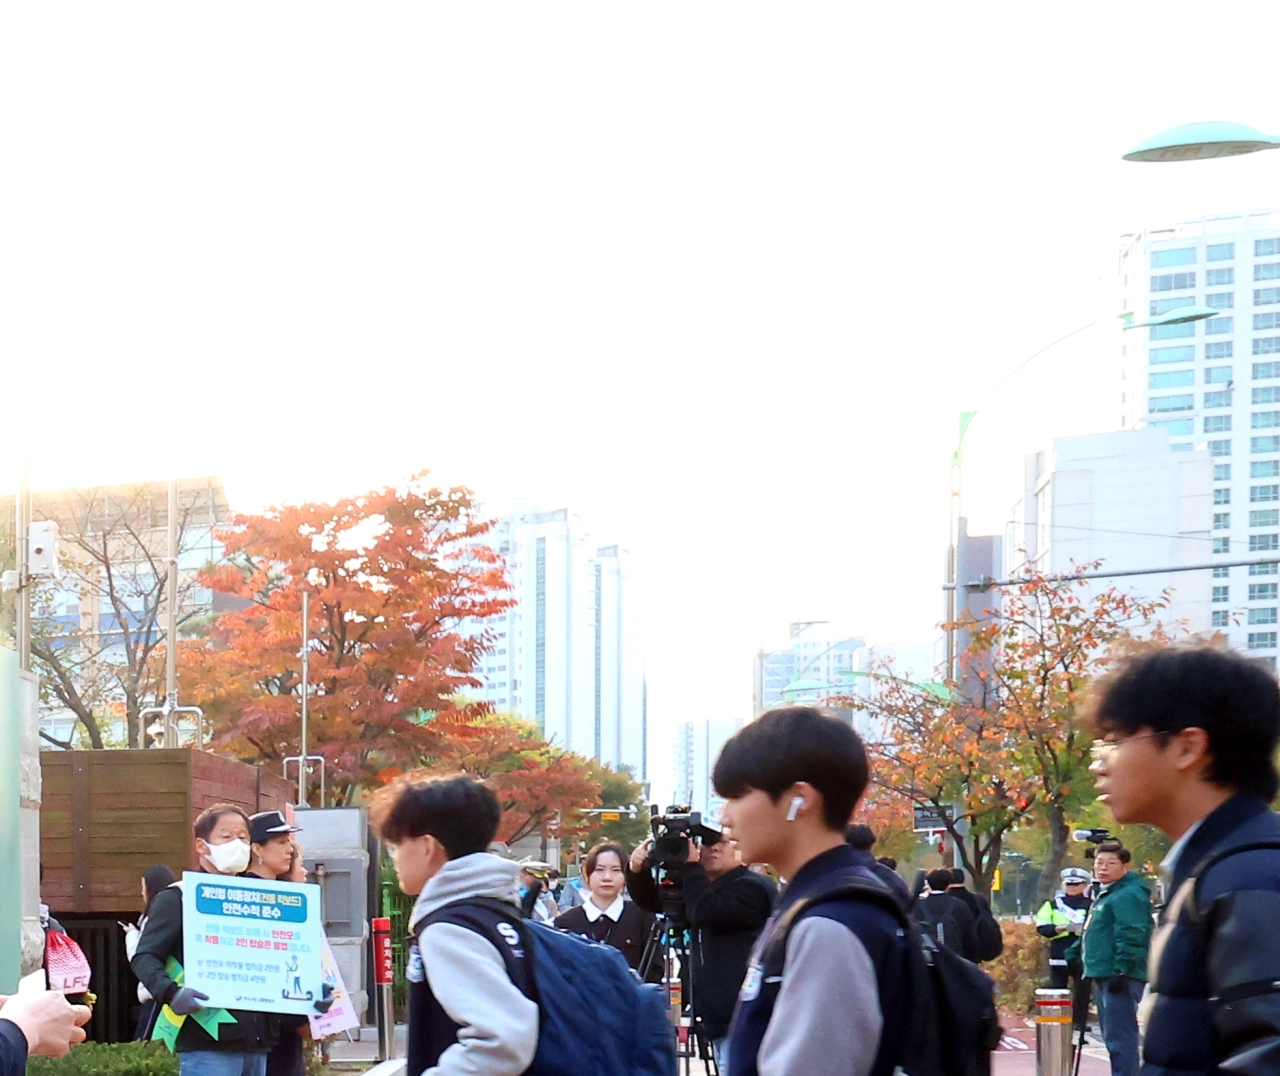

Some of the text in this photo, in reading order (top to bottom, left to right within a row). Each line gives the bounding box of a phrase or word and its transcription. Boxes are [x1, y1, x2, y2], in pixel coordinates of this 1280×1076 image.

[201, 886, 226, 900] 개인형
[222, 902, 282, 919] 안전수칙 준수
[496, 922, 520, 946] S
